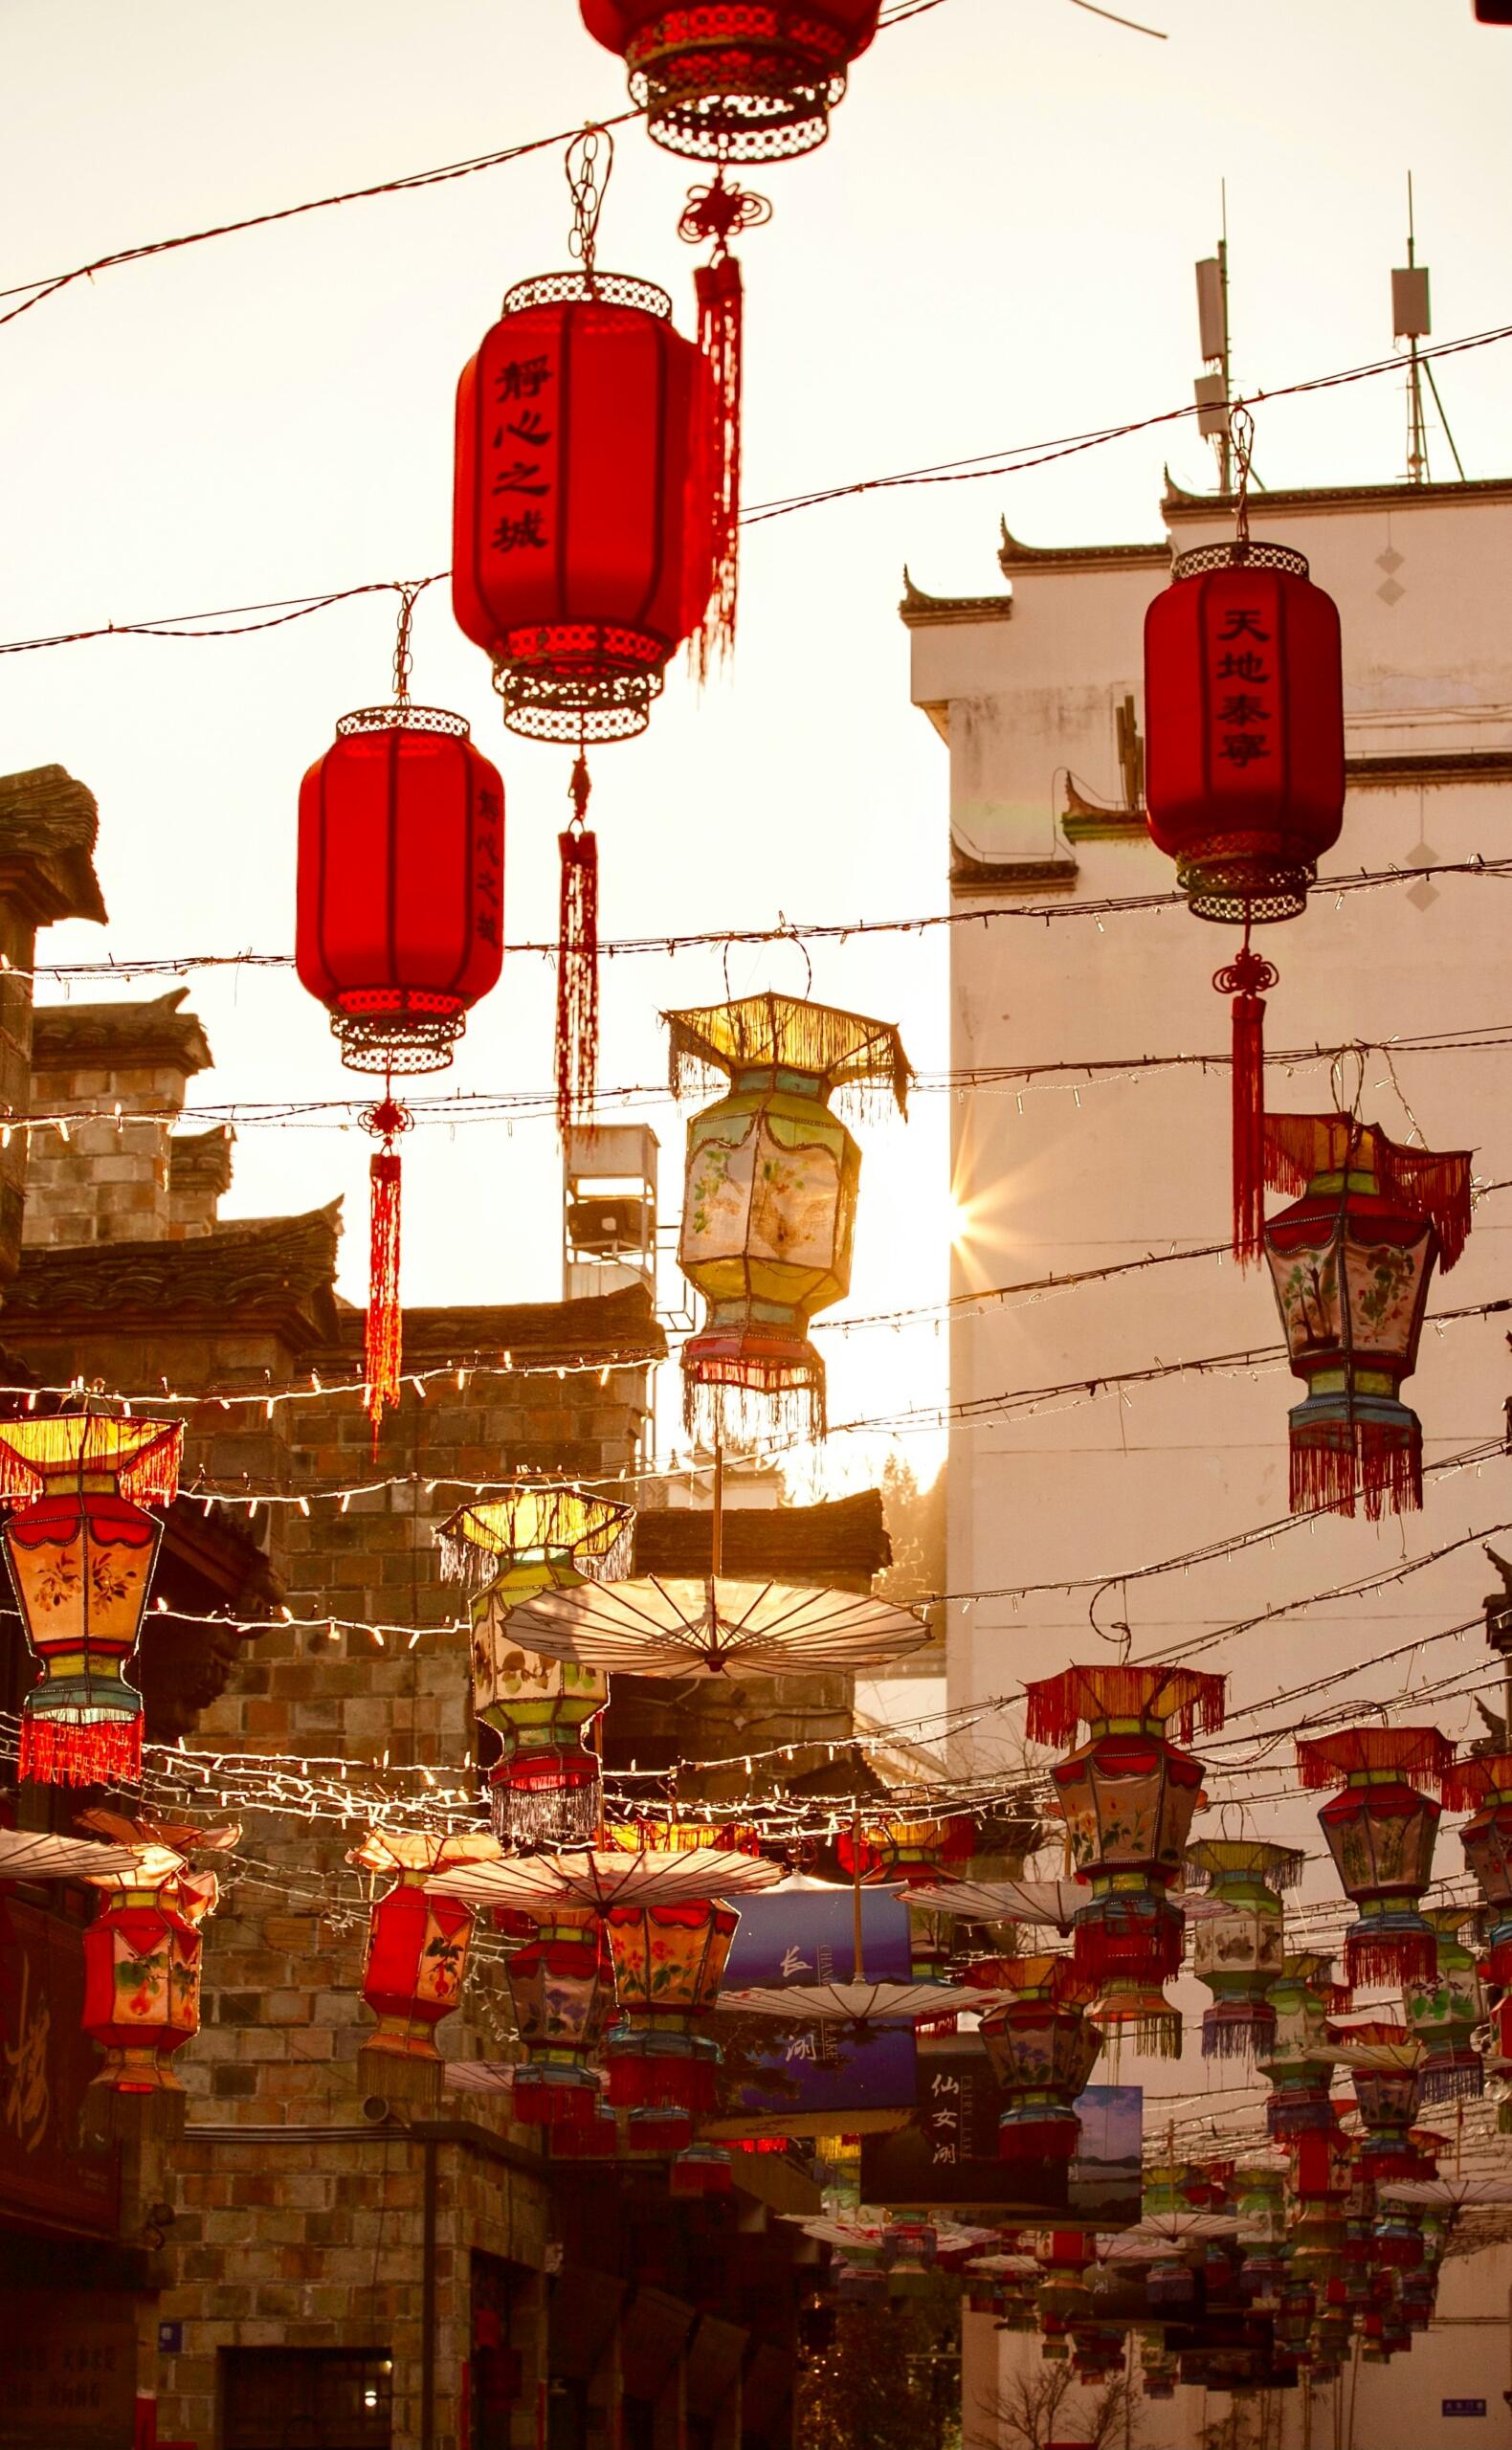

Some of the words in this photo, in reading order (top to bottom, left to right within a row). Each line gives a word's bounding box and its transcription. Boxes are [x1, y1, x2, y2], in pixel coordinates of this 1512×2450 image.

[492, 354, 552, 553] 靜心之城
[1216, 610, 1271, 768] 天地泰寧
[932, 2074, 960, 2165] 仙女湖
[963, 2075, 974, 2116] FAIRY
[963, 2127, 974, 2160] LAKE
